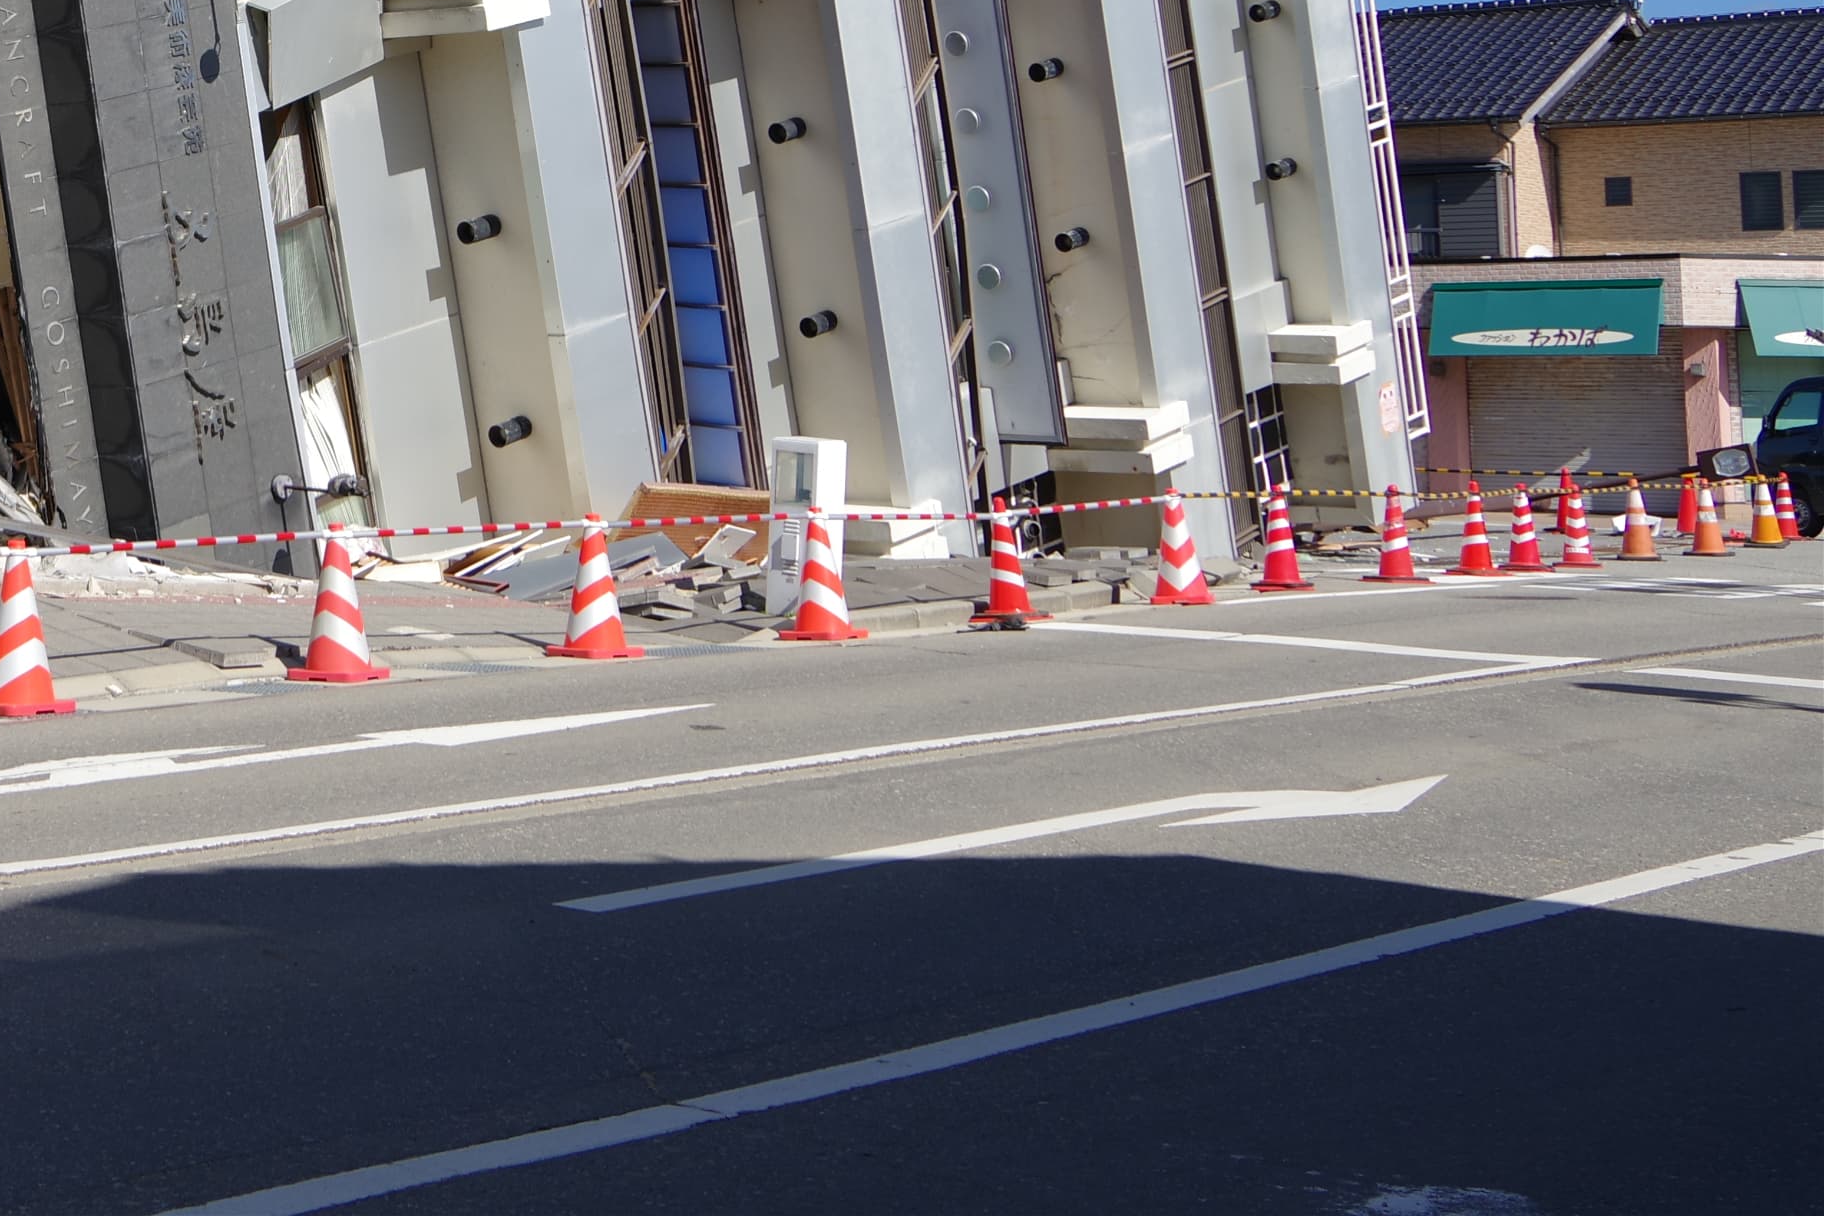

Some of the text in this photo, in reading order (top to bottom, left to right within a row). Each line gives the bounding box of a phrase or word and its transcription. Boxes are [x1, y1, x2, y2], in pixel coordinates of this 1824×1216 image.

[1527, 324, 1608, 348] わかば
[39, 286, 104, 534] GOSHIMAY
